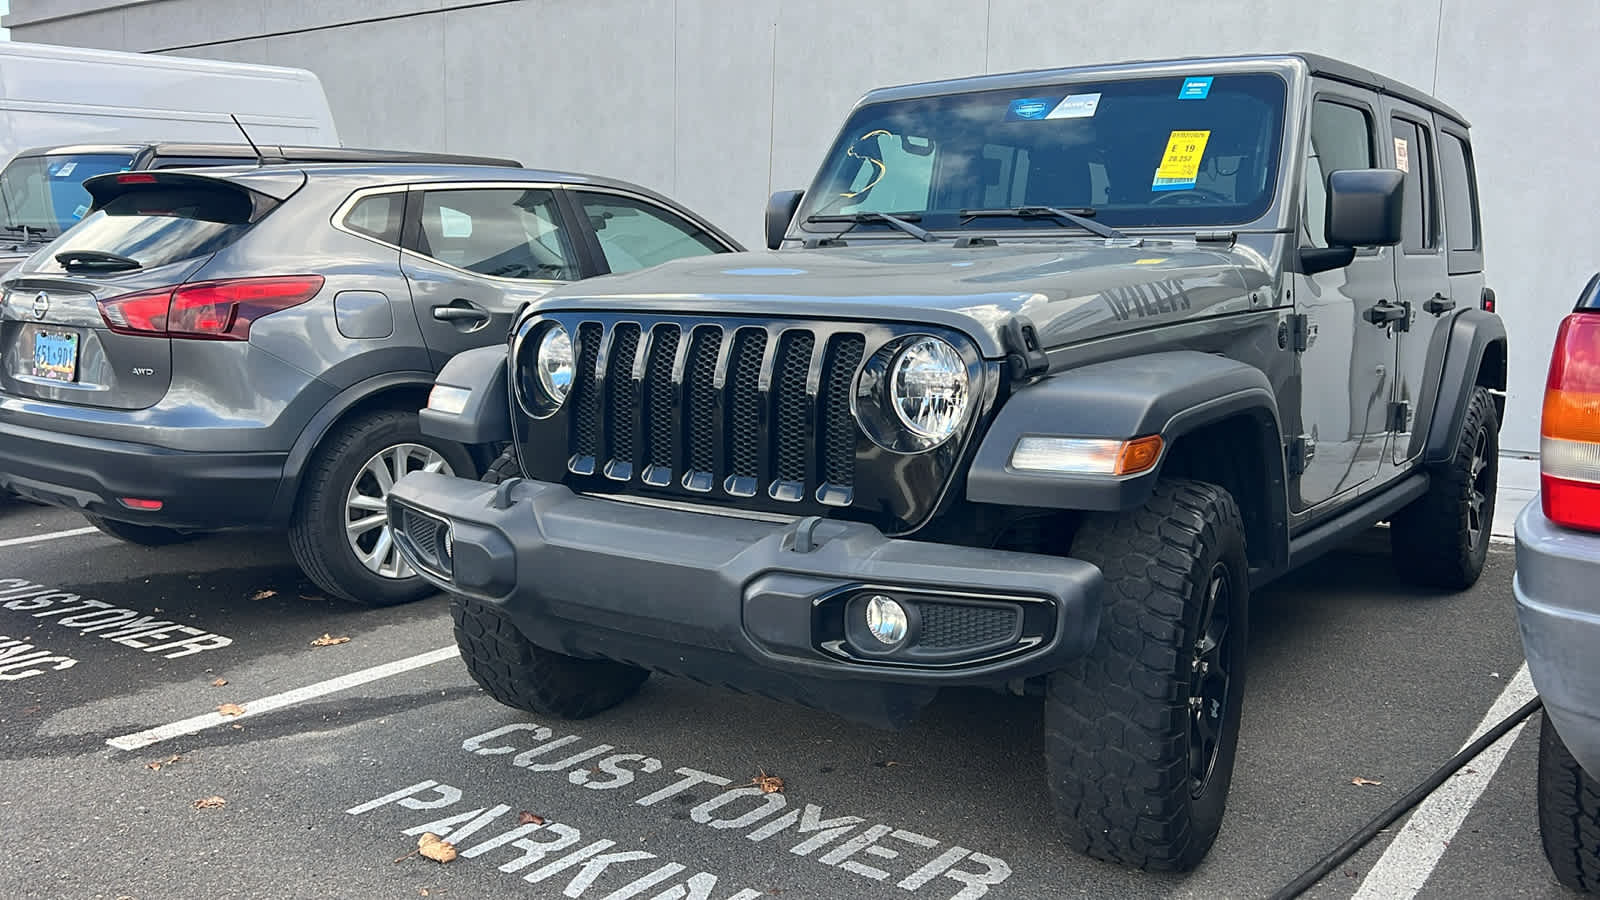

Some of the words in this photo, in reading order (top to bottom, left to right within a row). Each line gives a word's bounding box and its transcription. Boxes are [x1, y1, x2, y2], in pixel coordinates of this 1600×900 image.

[1100, 279, 1191, 320] WILLYS
[132, 367, 154, 376] AWD
[0, 578, 233, 659] USTOMER
[462, 722, 1013, 900] CUSTOMER
